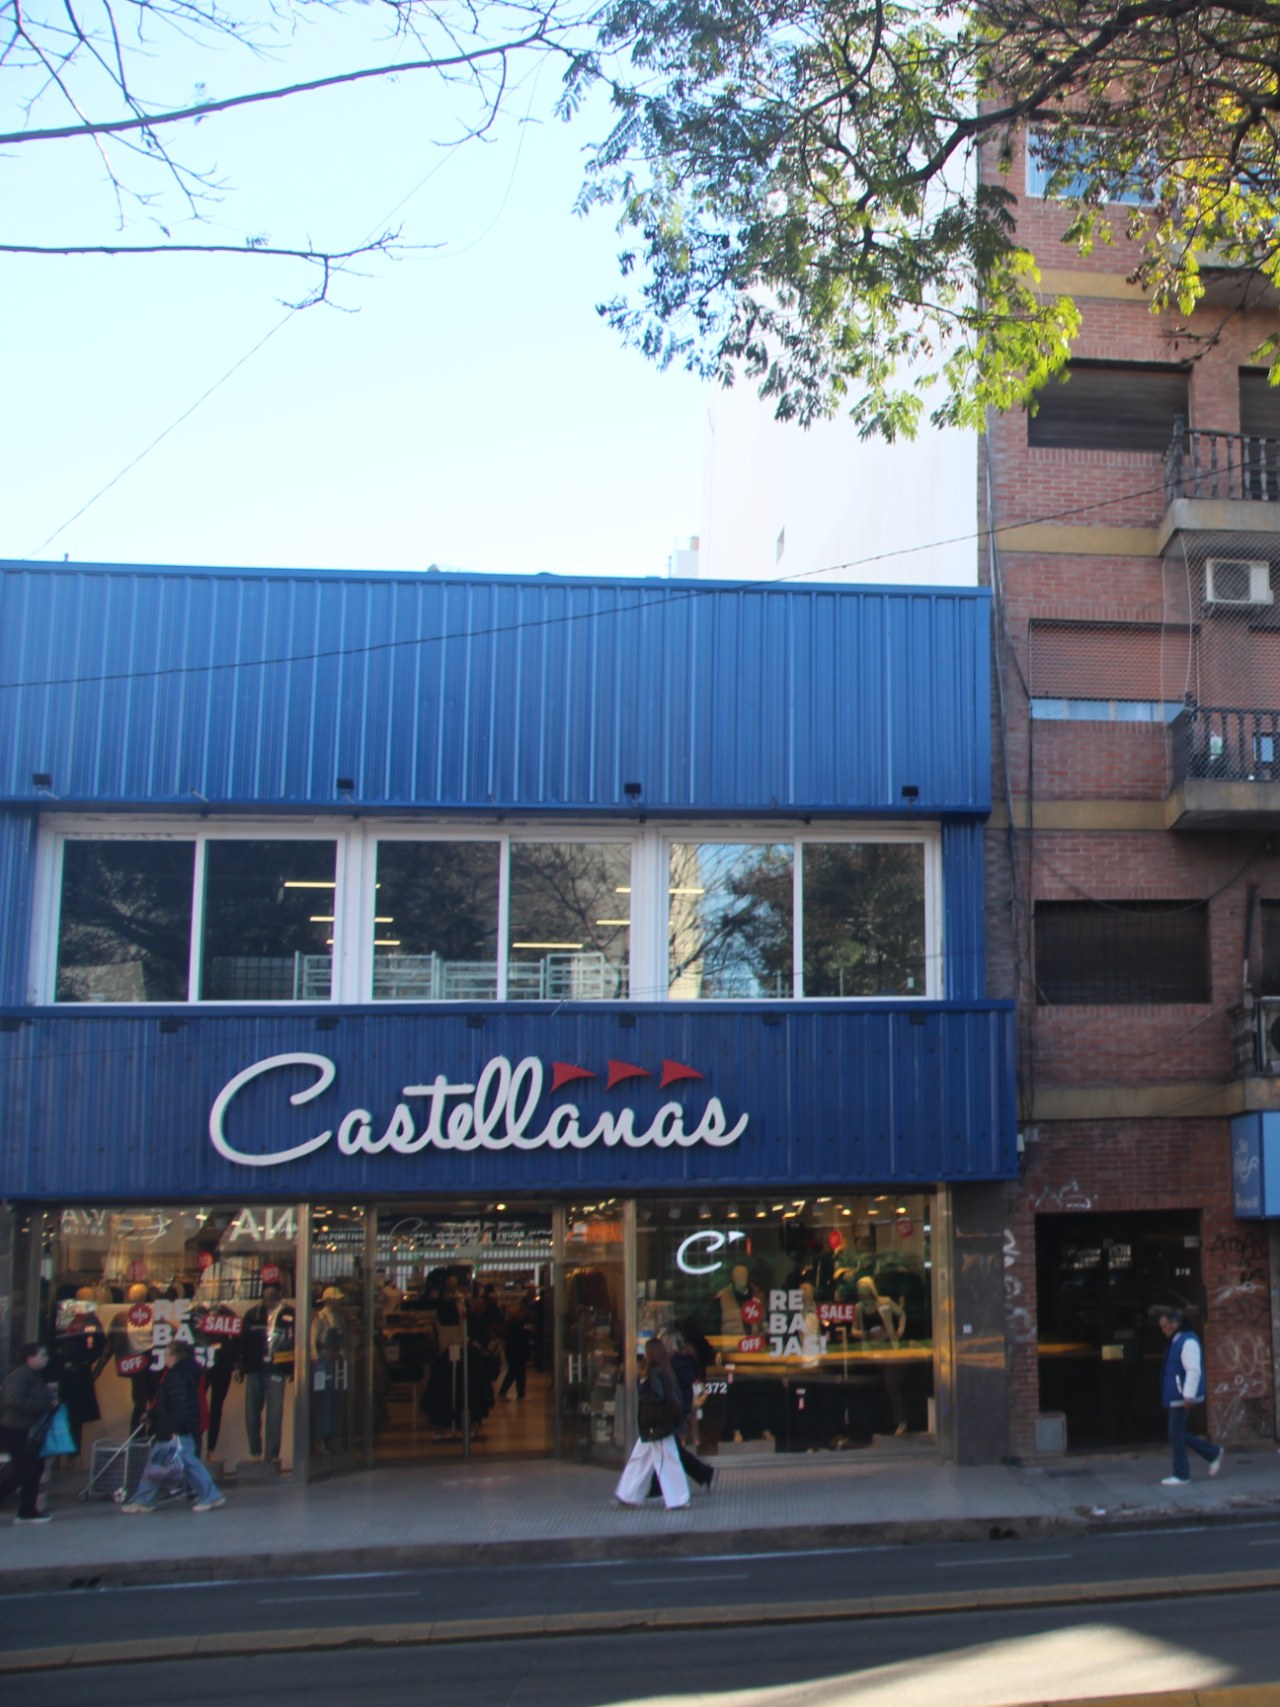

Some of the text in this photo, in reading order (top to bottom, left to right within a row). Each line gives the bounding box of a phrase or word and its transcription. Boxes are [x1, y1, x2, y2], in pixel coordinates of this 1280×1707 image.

[209, 1051, 749, 1167] Castellanas
[153, 1299, 192, 1321] RE
[769, 1289, 804, 1312] RE
[820, 1304, 854, 1320] SALE
[152, 1322, 195, 1345] BA
[204, 1316, 242, 1333] SALE
[769, 1312, 808, 1335] BA
[741, 1338, 761, 1352] OFF
[767, 1335, 828, 1359] JAS!
[120, 1356, 143, 1373] OFF
[149, 1346, 216, 1371] JS!
[704, 1382, 728, 1395] 372
